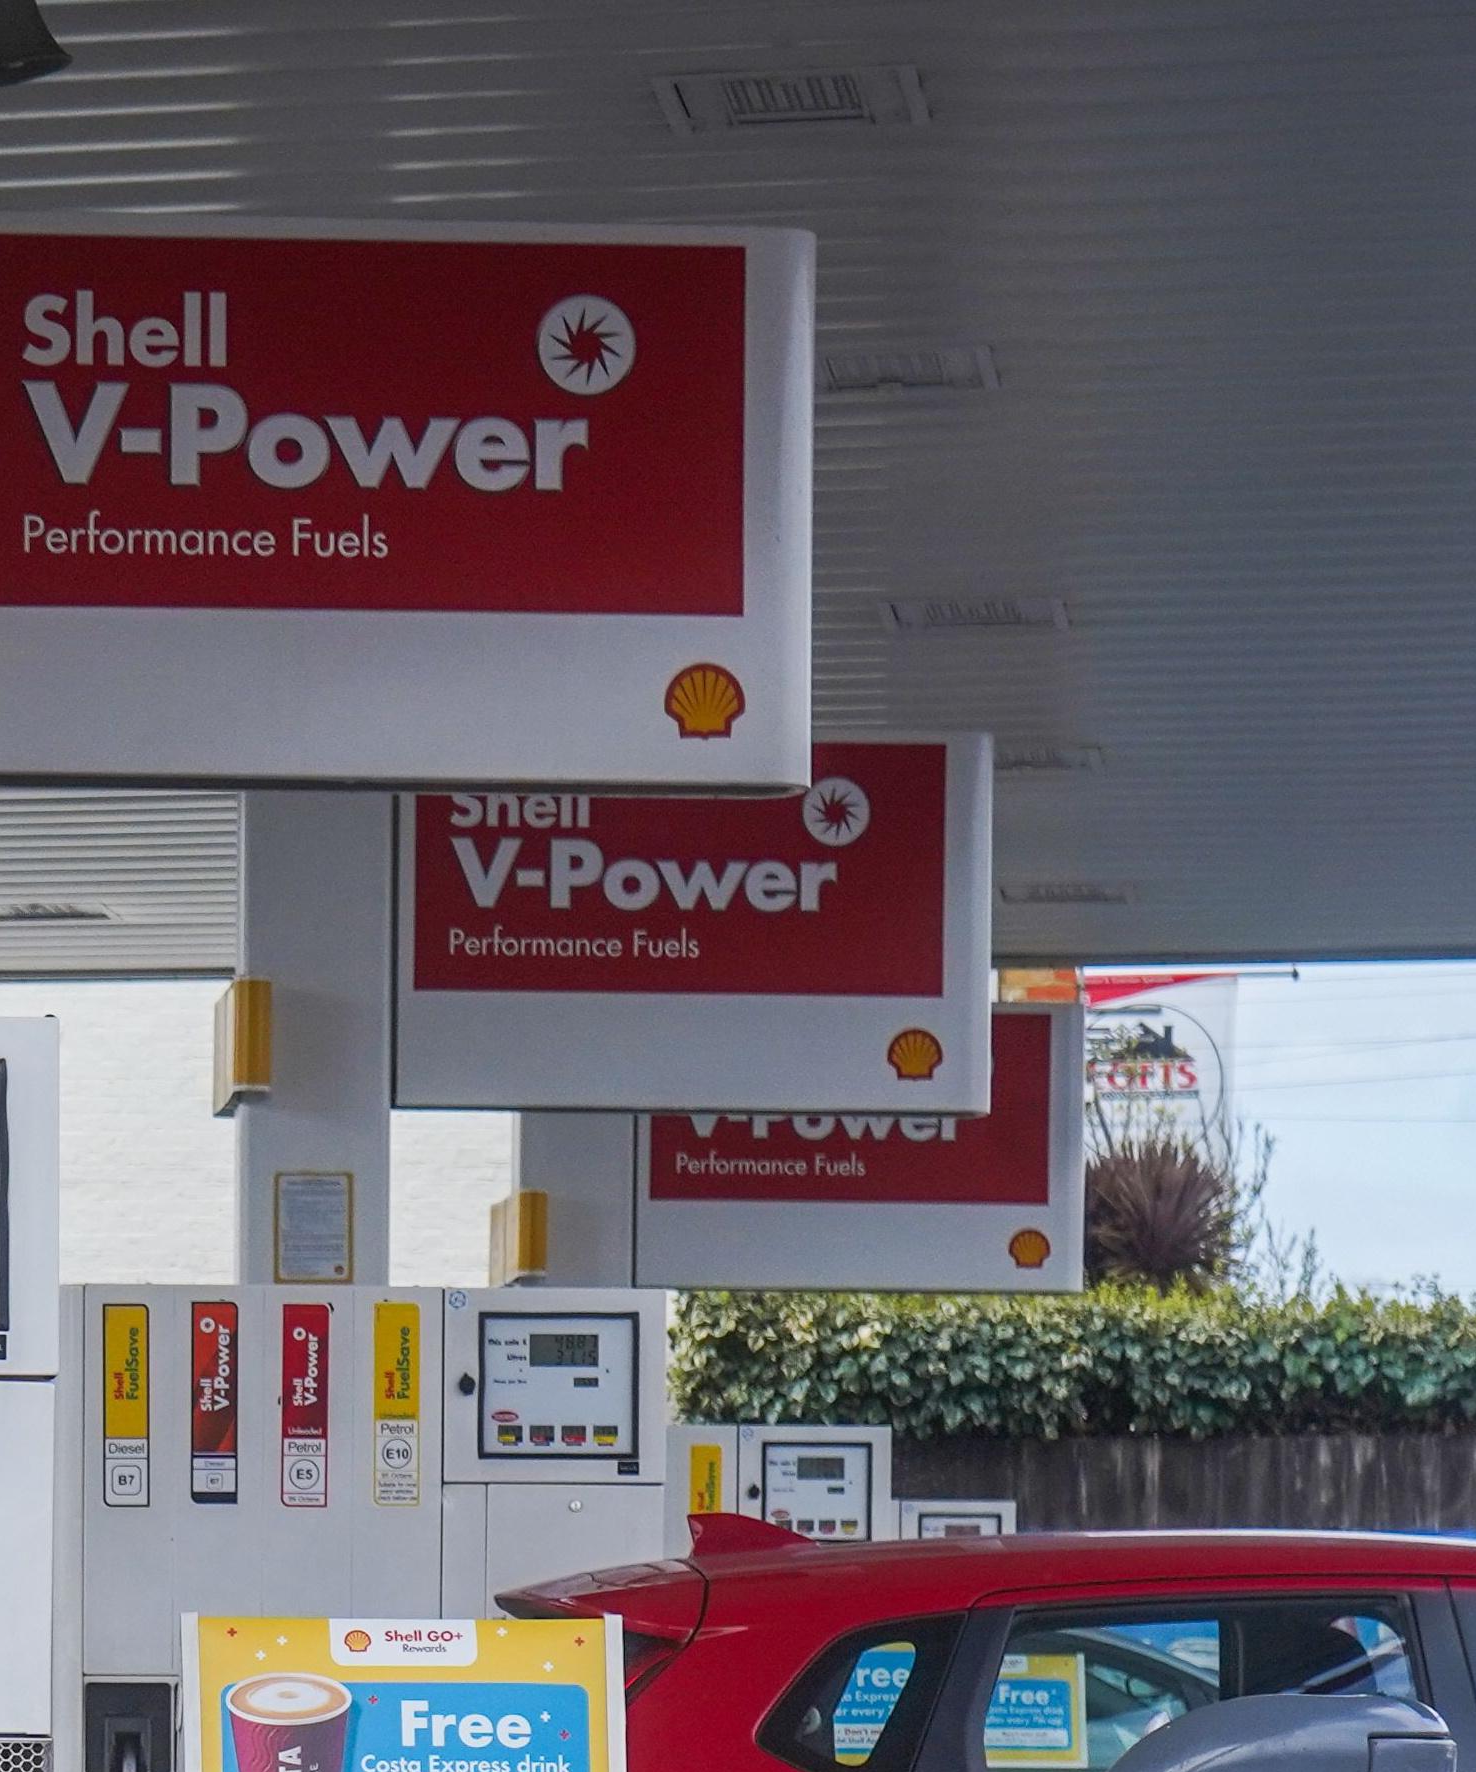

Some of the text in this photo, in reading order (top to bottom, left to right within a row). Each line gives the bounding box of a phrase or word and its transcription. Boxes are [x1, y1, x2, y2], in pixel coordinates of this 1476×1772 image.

[22, 291, 228, 368] Shell
[22, 381, 589, 491] V-Power
[22, 511, 389, 559] Performance Fuels
[450, 795, 591, 828] Shell
[450, 838, 838, 912] V-Power
[449, 926, 700, 959] Performance Fuels
[675, 1151, 866, 1177] Performance Fuels
[114, 1327, 140, 1401] Shell FuelSave
[200, 1324, 230, 1412] Shell V-Power
[292, 1333, 319, 1407] Shell V-Power
[385, 1326, 411, 1400] Shell FuelSave
[380, 1423, 414, 1434] Petrol
[108, 1442, 145, 1455] Diesel
[288, 1442, 322, 1453] Petrol
[386, 1449, 409, 1460] E10
[118, 1475, 135, 1486] B7
[296, 1469, 313, 1480] E5
[384, 1629, 464, 1643] Shell GO+
[402, 1643, 447, 1654] Rewards
[853, 1667, 910, 1688] ree
[999, 1683, 1050, 1705] Free
[400, 1700, 532, 1749] Free
